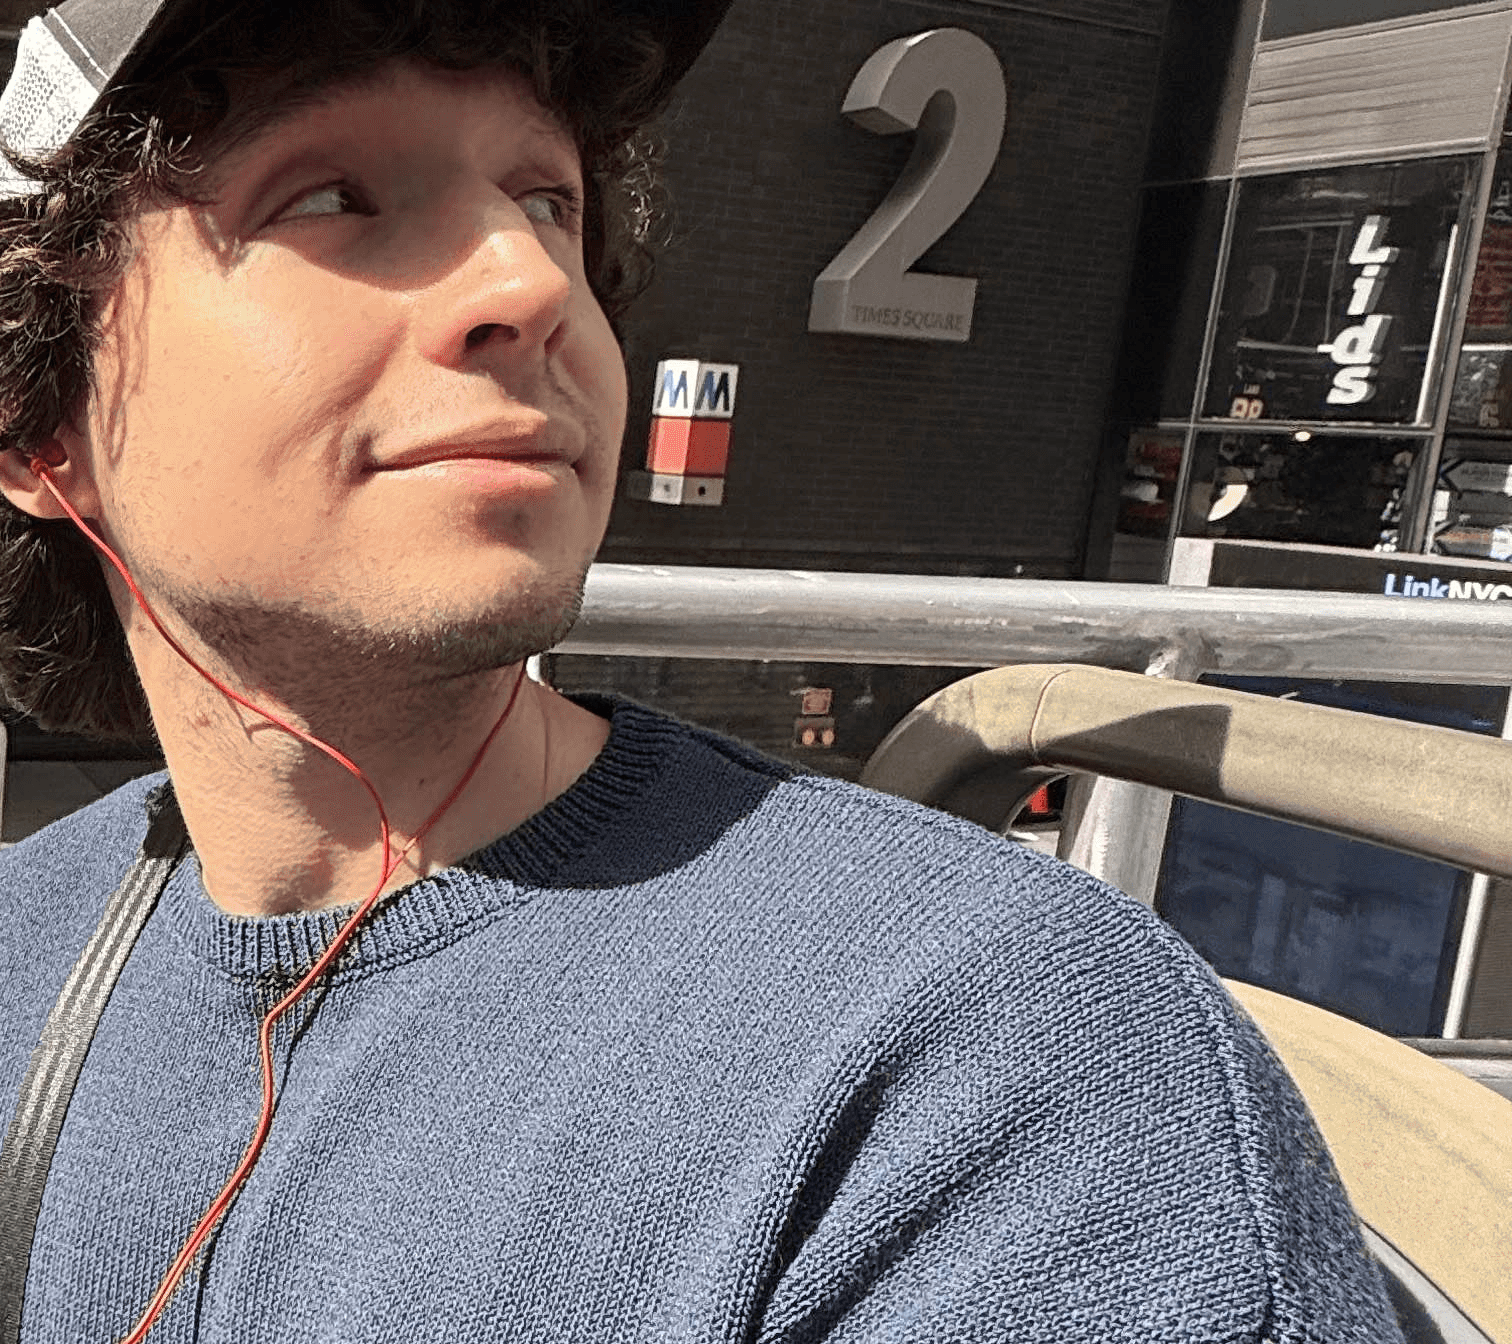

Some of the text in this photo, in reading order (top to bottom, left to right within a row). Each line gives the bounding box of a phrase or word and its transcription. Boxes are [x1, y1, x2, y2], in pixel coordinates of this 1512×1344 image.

[808, 27, 1007, 342] 2
[852, 304, 966, 332] TIMES SQUARE
[1326, 214, 1400, 405] Lids
